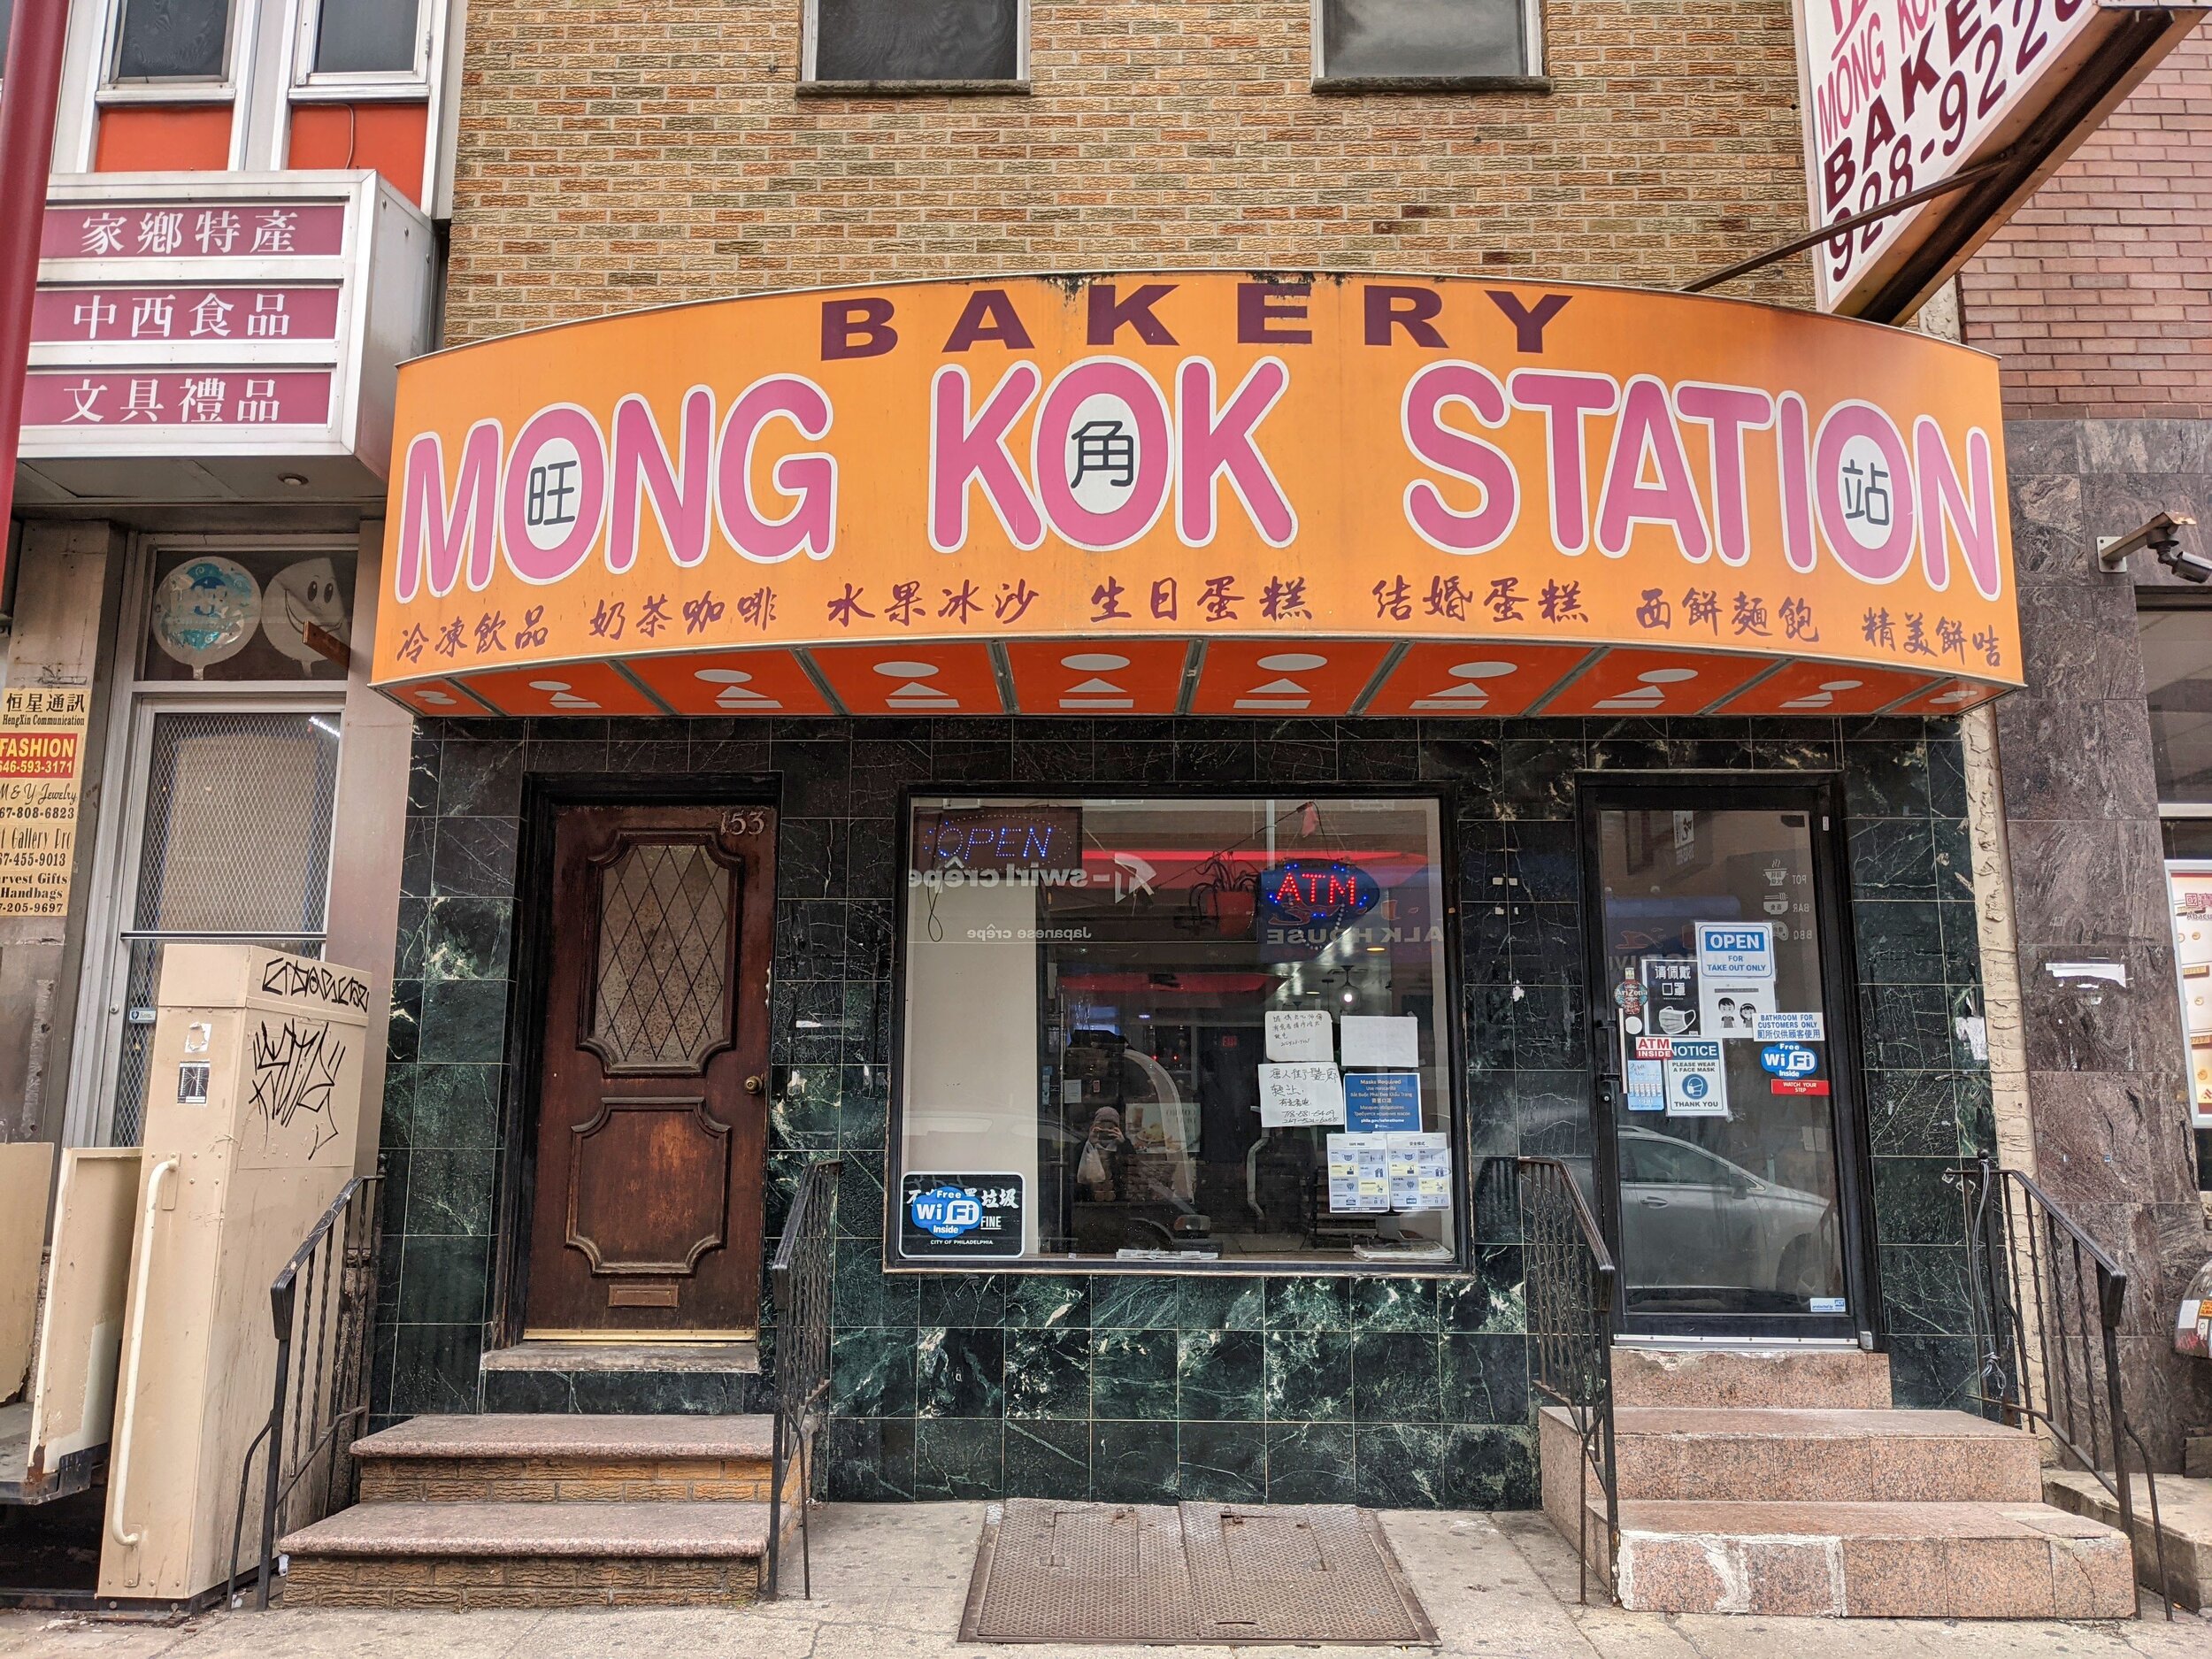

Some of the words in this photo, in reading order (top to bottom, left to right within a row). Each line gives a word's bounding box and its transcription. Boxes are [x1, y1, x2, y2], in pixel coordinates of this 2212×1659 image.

[1818, 12, 1886, 155] MONG
[1824, 0, 2002, 215] BAKE
[1829, 0, 2081, 282] 928-922
[81, 210, 298, 255] 家鄉特產
[73, 293, 290, 339] 中西食品
[821, 283, 1572, 361] BAKERY
[61, 378, 280, 423] 文具禮品
[395, 373, 837, 603] MONG
[928, 355, 1297, 553] KOK
[1402, 360, 2001, 602] STATION
[526, 459, 578, 526] 旺
[1070, 420, 1134, 488] 角
[1842, 458, 1889, 526] 站
[588, 586, 778, 642] 奶茶咖啡
[827, 579, 1040, 628] 水果冰沙
[1089, 576, 1313, 623] 生日蛋糕
[6, 693, 85, 713] 恒星通訊
[3, 714, 31, 728] HengXin
[33, 714, 85, 726] Communication
[11, 784, 21, 801] &
[38, 783, 77, 807] Jewelry
[720, 810, 765, 835] 153
[12, 826, 50, 850] Gallery
[938, 827, 1053, 860] OPEN
[38, 872, 68, 884] Gifts
[1276, 872, 1357, 905] ATM
[1, 887, 63, 902] Handbags
[1709, 933, 1760, 949] OPEN
[1655, 965, 1691, 979] 请佩戴
[1662, 982, 1686, 996] 口罩
[1638, 1038, 1670, 1048] ATM
[1671, 1045, 1717, 1056] NOTICE
[936, 1190, 962, 1199] Free
[933, 1225, 959, 1234] Inside
[980, 1216, 1002, 1228] FINE
